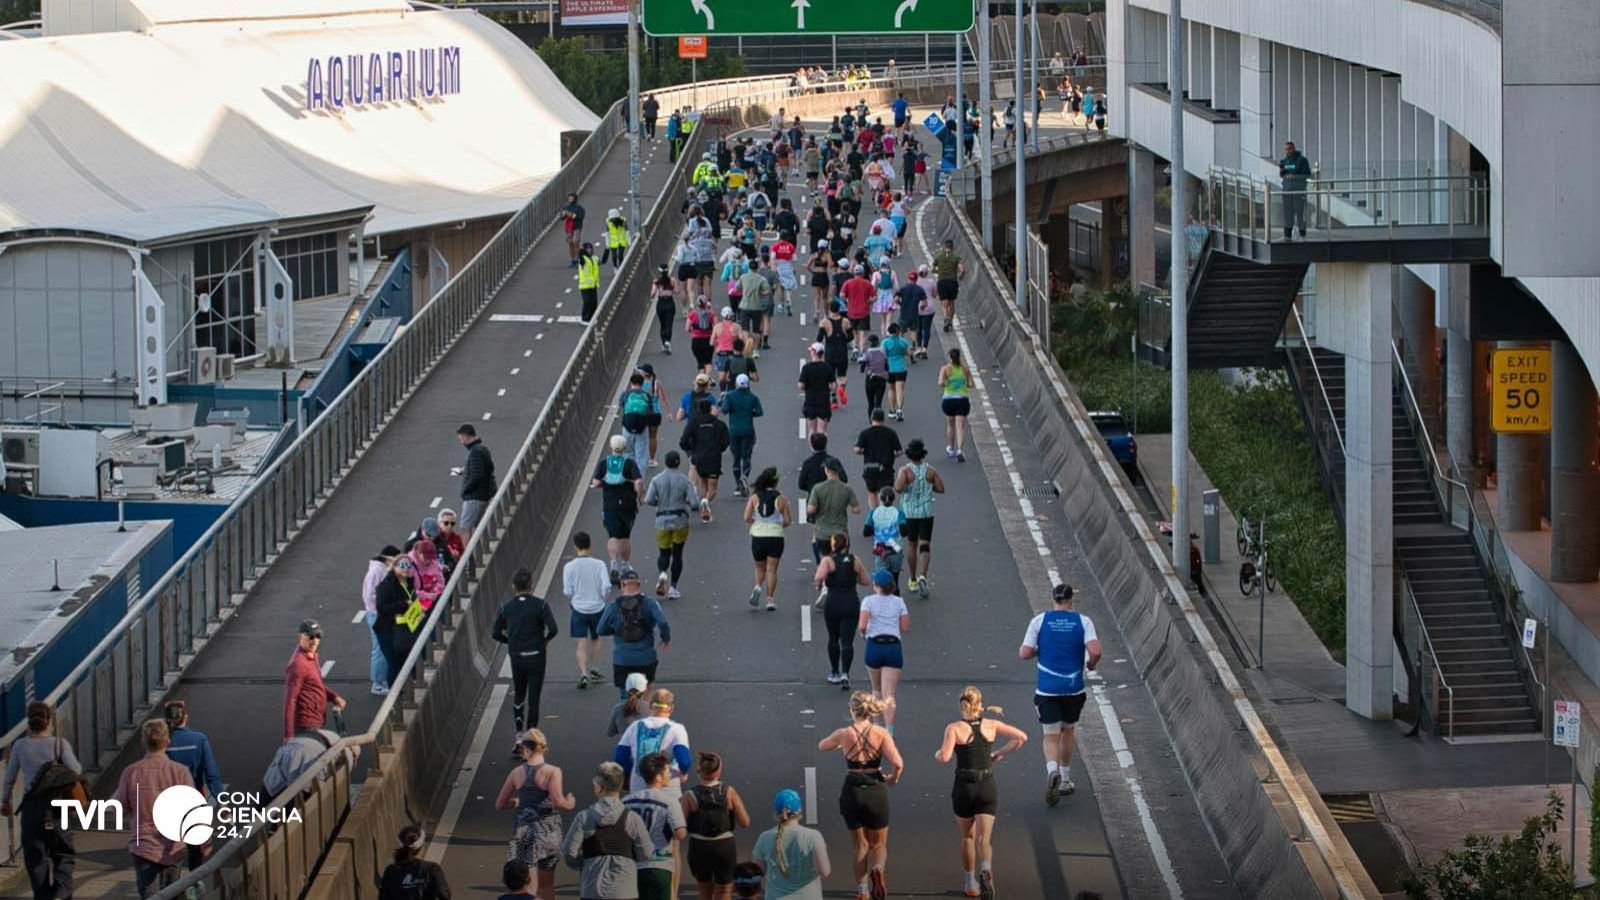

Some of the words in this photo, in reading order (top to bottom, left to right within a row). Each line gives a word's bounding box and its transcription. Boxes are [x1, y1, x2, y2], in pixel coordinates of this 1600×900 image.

[307, 46, 461, 110] AQUARIUM
[1507, 356, 1539, 368] EXIT
[1500, 372, 1548, 384] SPEED
[1506, 388, 1540, 410] 50
[1506, 414, 1540, 426] km/h
